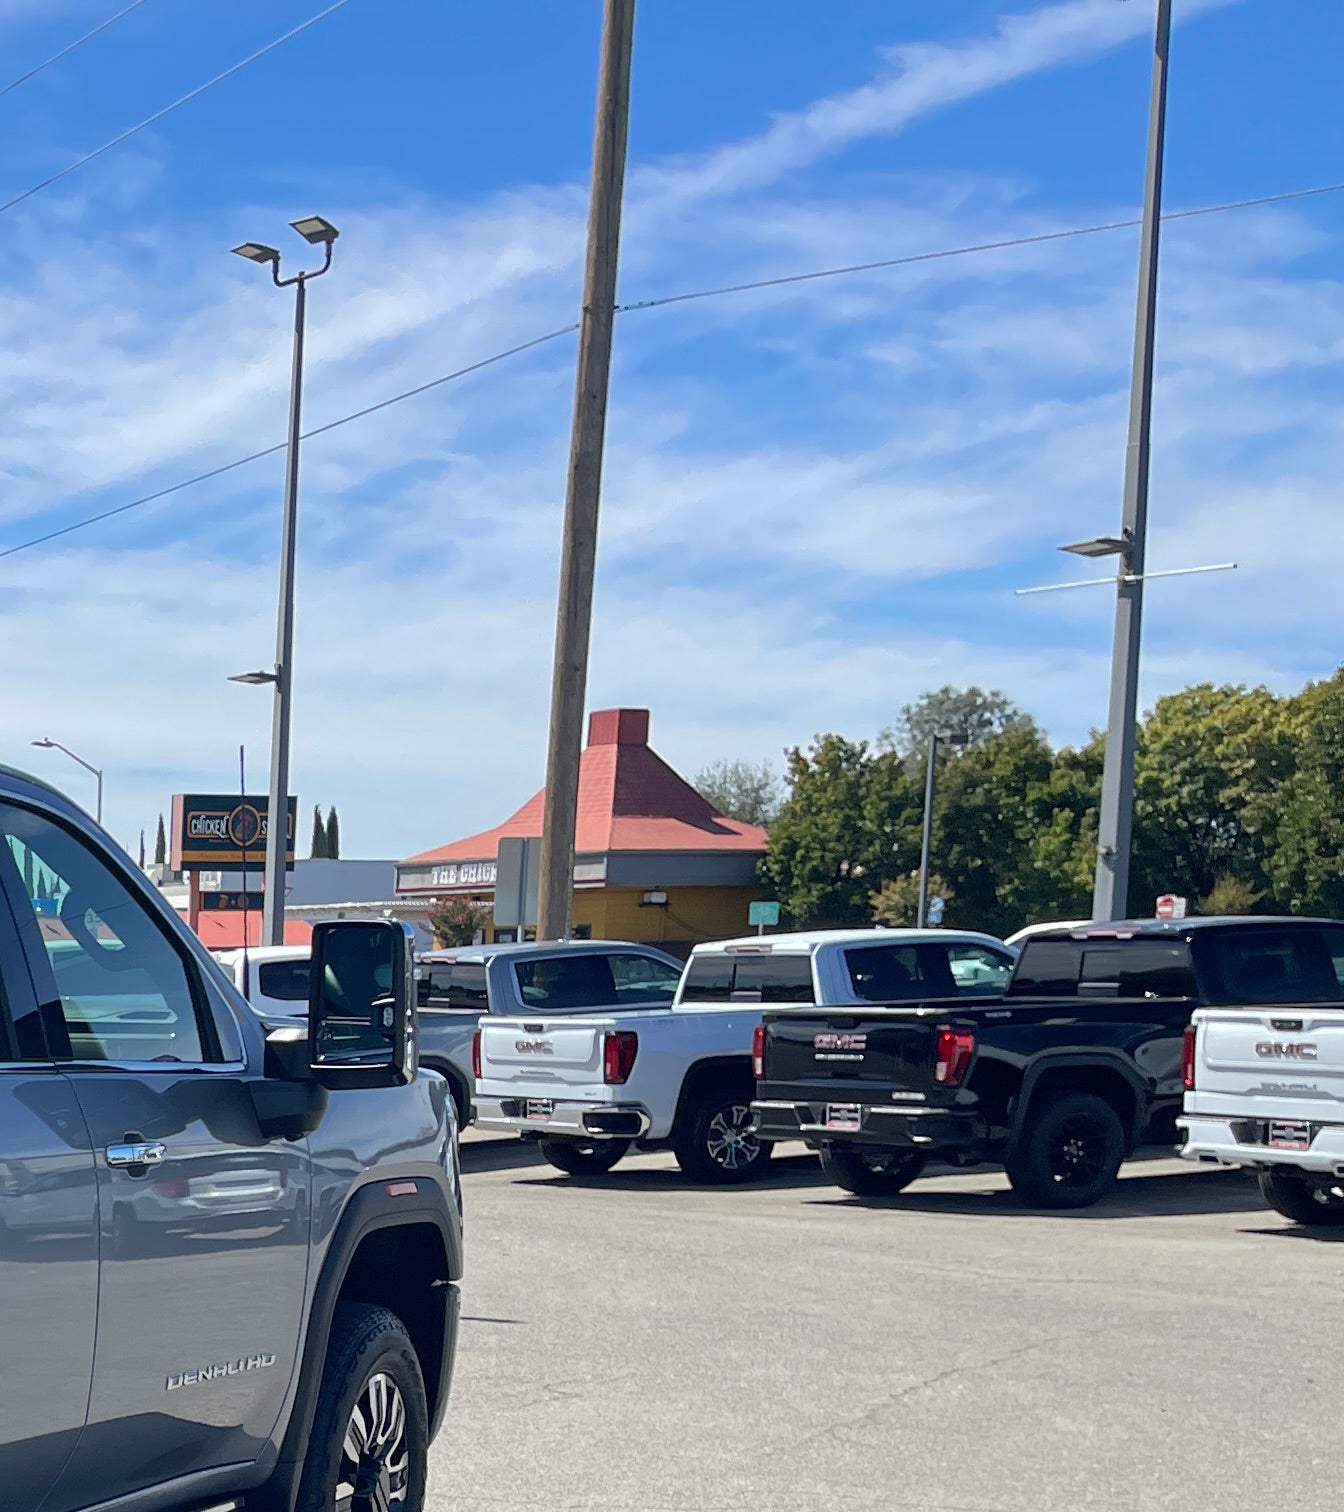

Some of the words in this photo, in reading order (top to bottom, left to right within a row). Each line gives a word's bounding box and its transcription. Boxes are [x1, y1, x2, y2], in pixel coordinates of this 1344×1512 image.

[191, 815, 230, 838] CHICKEN
[432, 864, 458, 885] THE
[1255, 1041, 1318, 1060] GMC
[166, 1358, 244, 1391] DENALI
[246, 1352, 276, 1371] HD
